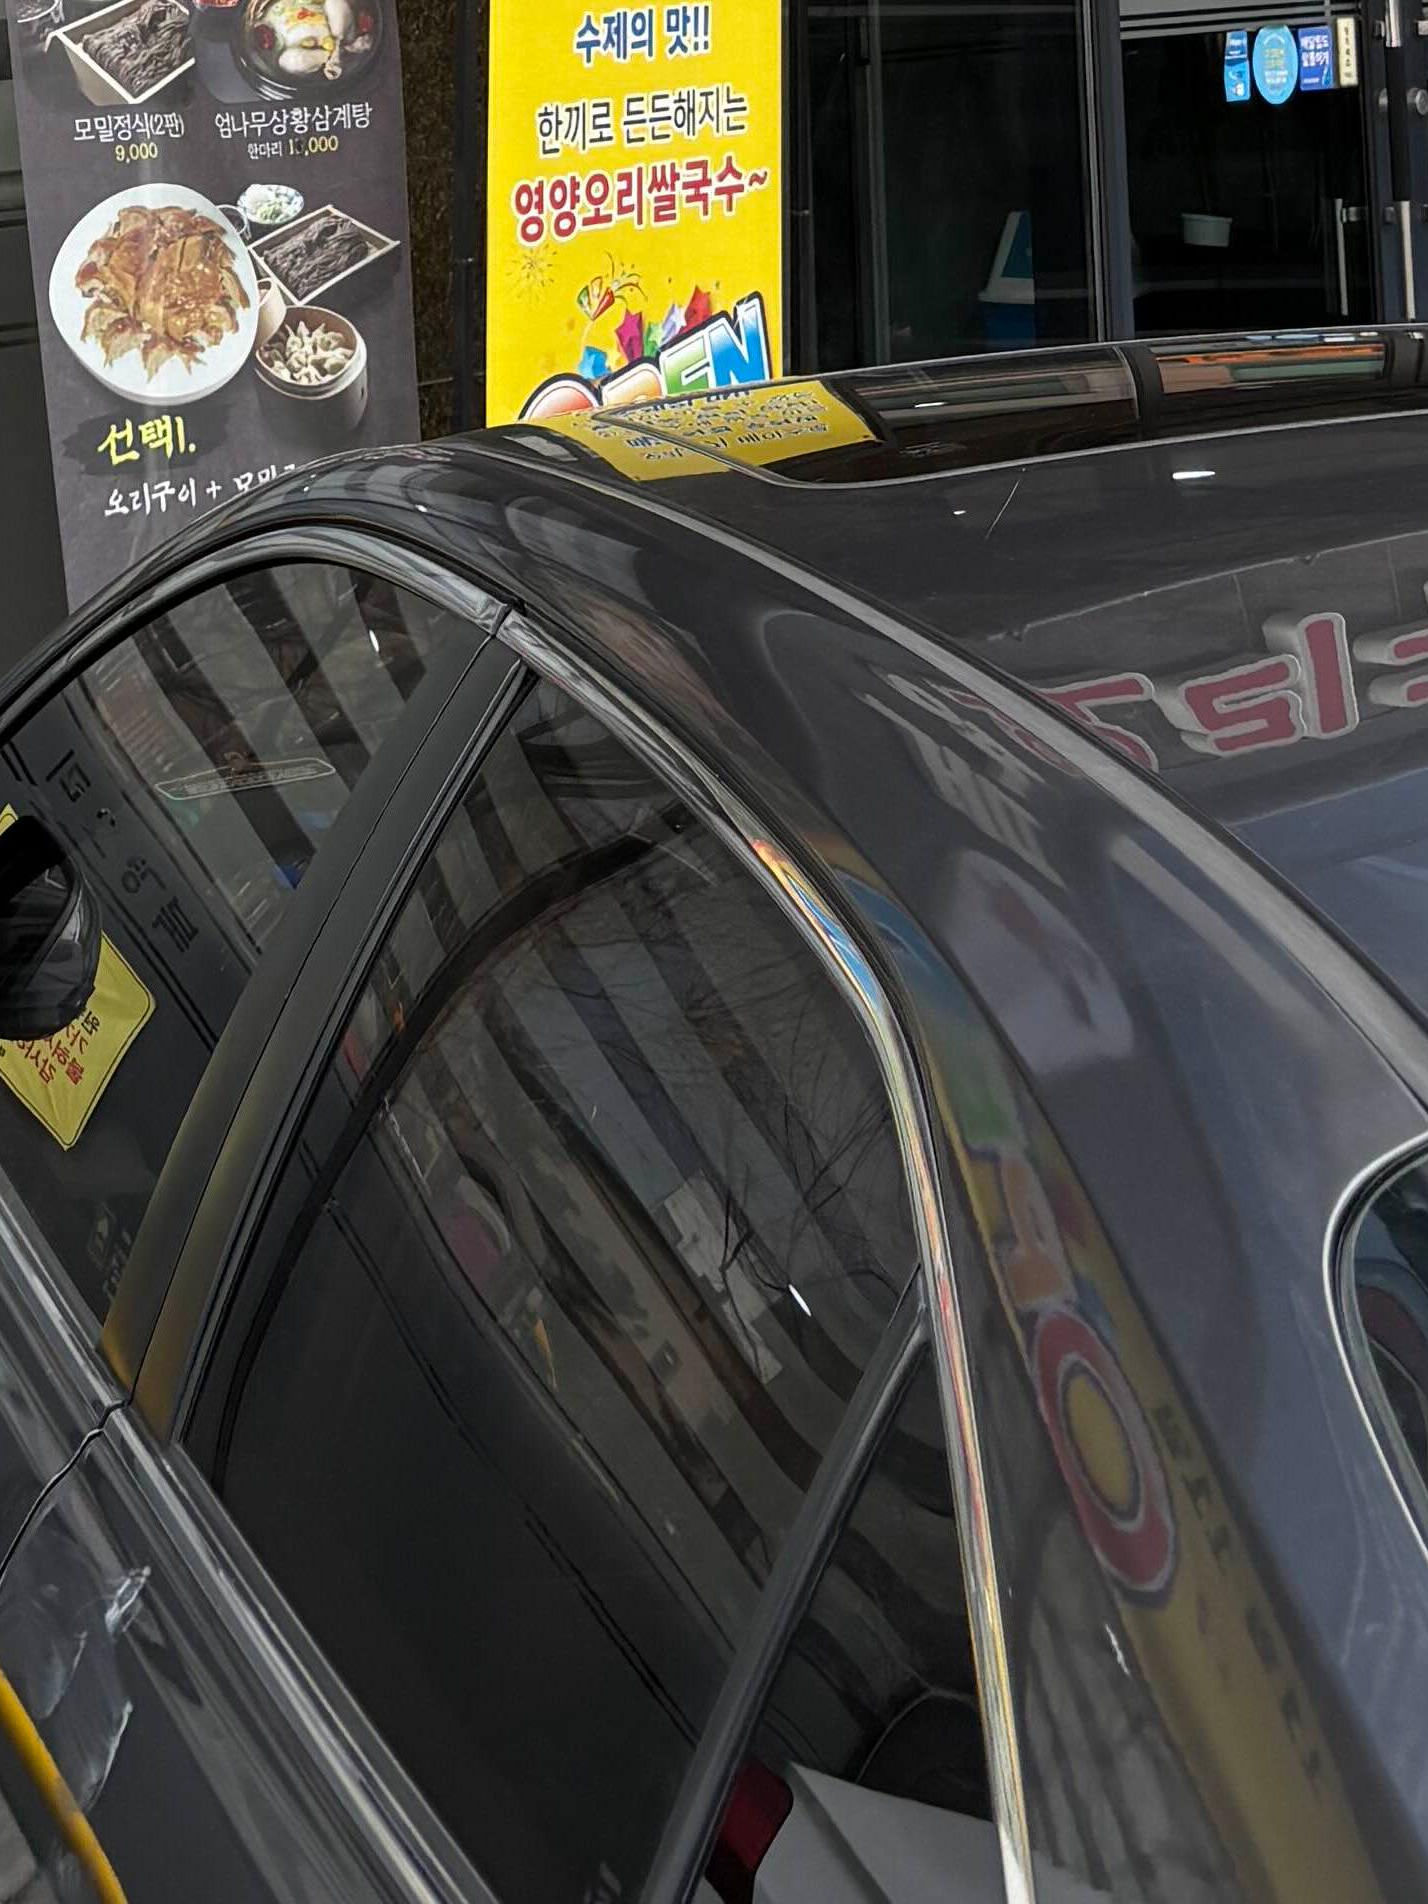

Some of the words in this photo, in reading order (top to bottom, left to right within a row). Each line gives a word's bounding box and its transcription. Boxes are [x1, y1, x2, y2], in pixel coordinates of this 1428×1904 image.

[575, 8, 654, 64] 수제의
[665, 4, 710, 55] 맛!!
[72, 110, 186, 144] 모밀정식(2판)
[214, 101, 373, 140] 엄나무상황삼계탕
[537, 101, 615, 156] 한끼로
[622, 85, 748, 145] 든든해지는
[115, 142, 159, 164] 9,000
[247, 140, 284, 160] 한마리
[104, 476, 198, 519] 오리구이
